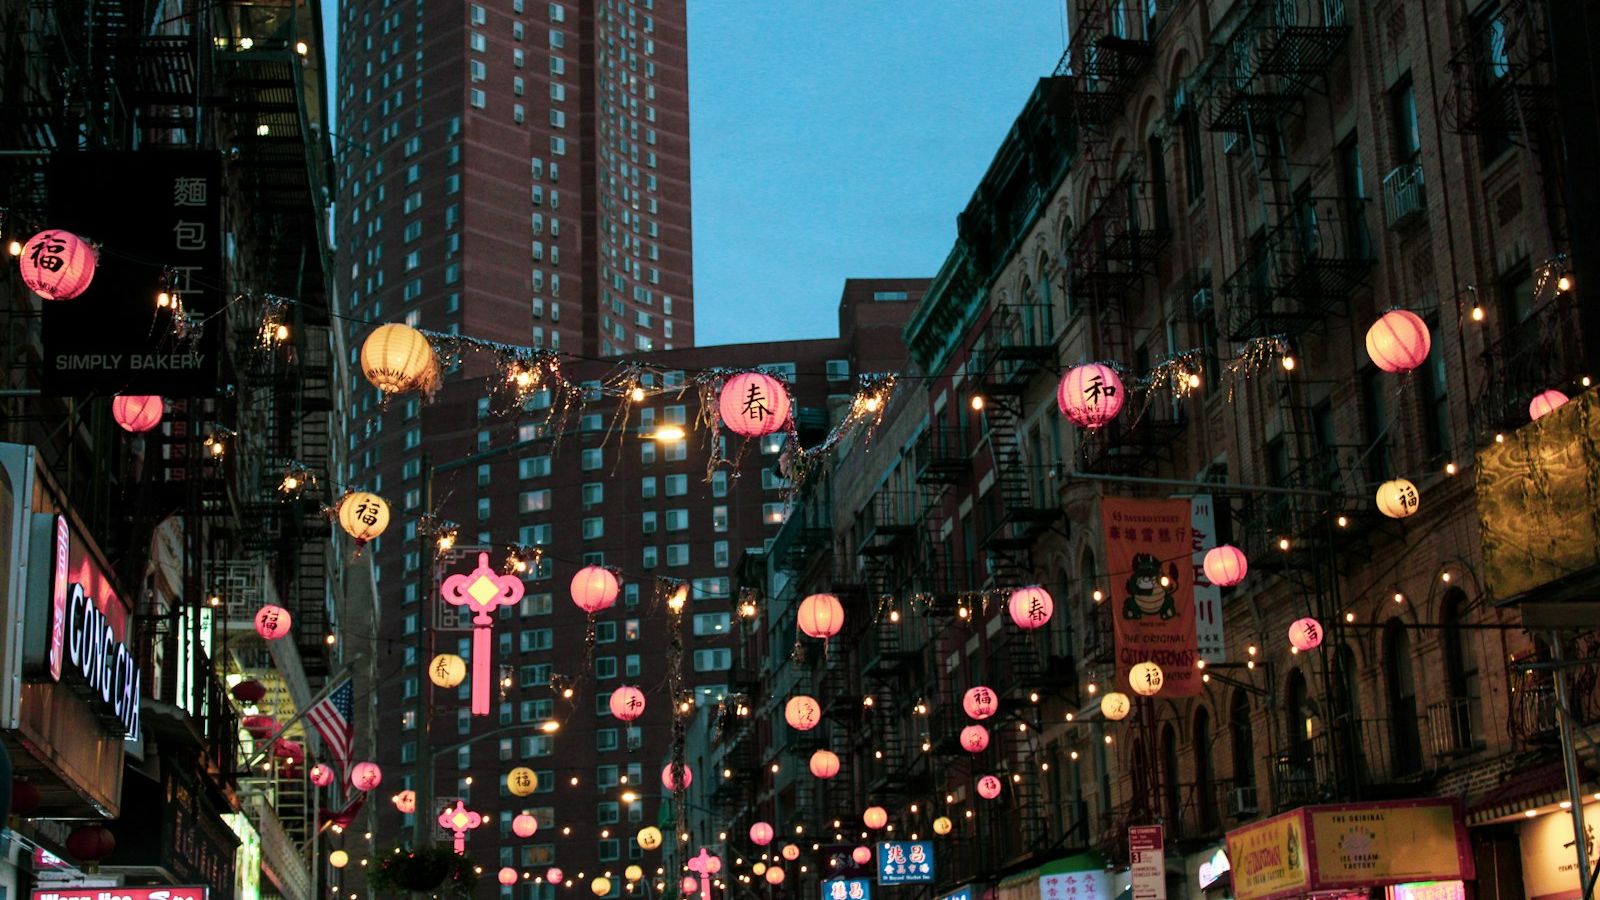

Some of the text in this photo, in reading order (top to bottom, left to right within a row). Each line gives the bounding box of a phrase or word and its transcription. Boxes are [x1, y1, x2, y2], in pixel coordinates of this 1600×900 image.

[30, 234, 67, 273] 福
[56, 354, 206, 370] SIMPLY BAKERY
[1084, 375, 1116, 405] 和
[742, 383, 774, 421] 春
[1400, 486, 1418, 507] 福
[356, 499, 381, 527] 福
[1028, 597, 1048, 621] 春
[261, 610, 279, 631] 福
[1124, 634, 1140, 643] THE
[1143, 633, 1186, 643] ORIGINAL
[1120, 647, 1194, 667] CHINATOWN
[435, 657, 450, 679] 春
[1145, 668, 1161, 687] 福
[114, 642, 141, 742] CHA
[973, 689, 991, 705] 福
[626, 696, 642, 711] 和
[515, 771, 531, 787] 福
[1331, 814, 1385, 823] THE ORIGINAL
[886, 844, 926, 865] 兆昌
[1353, 854, 1379, 862] CREAM
[1344, 862, 1377, 870] FACTORY
